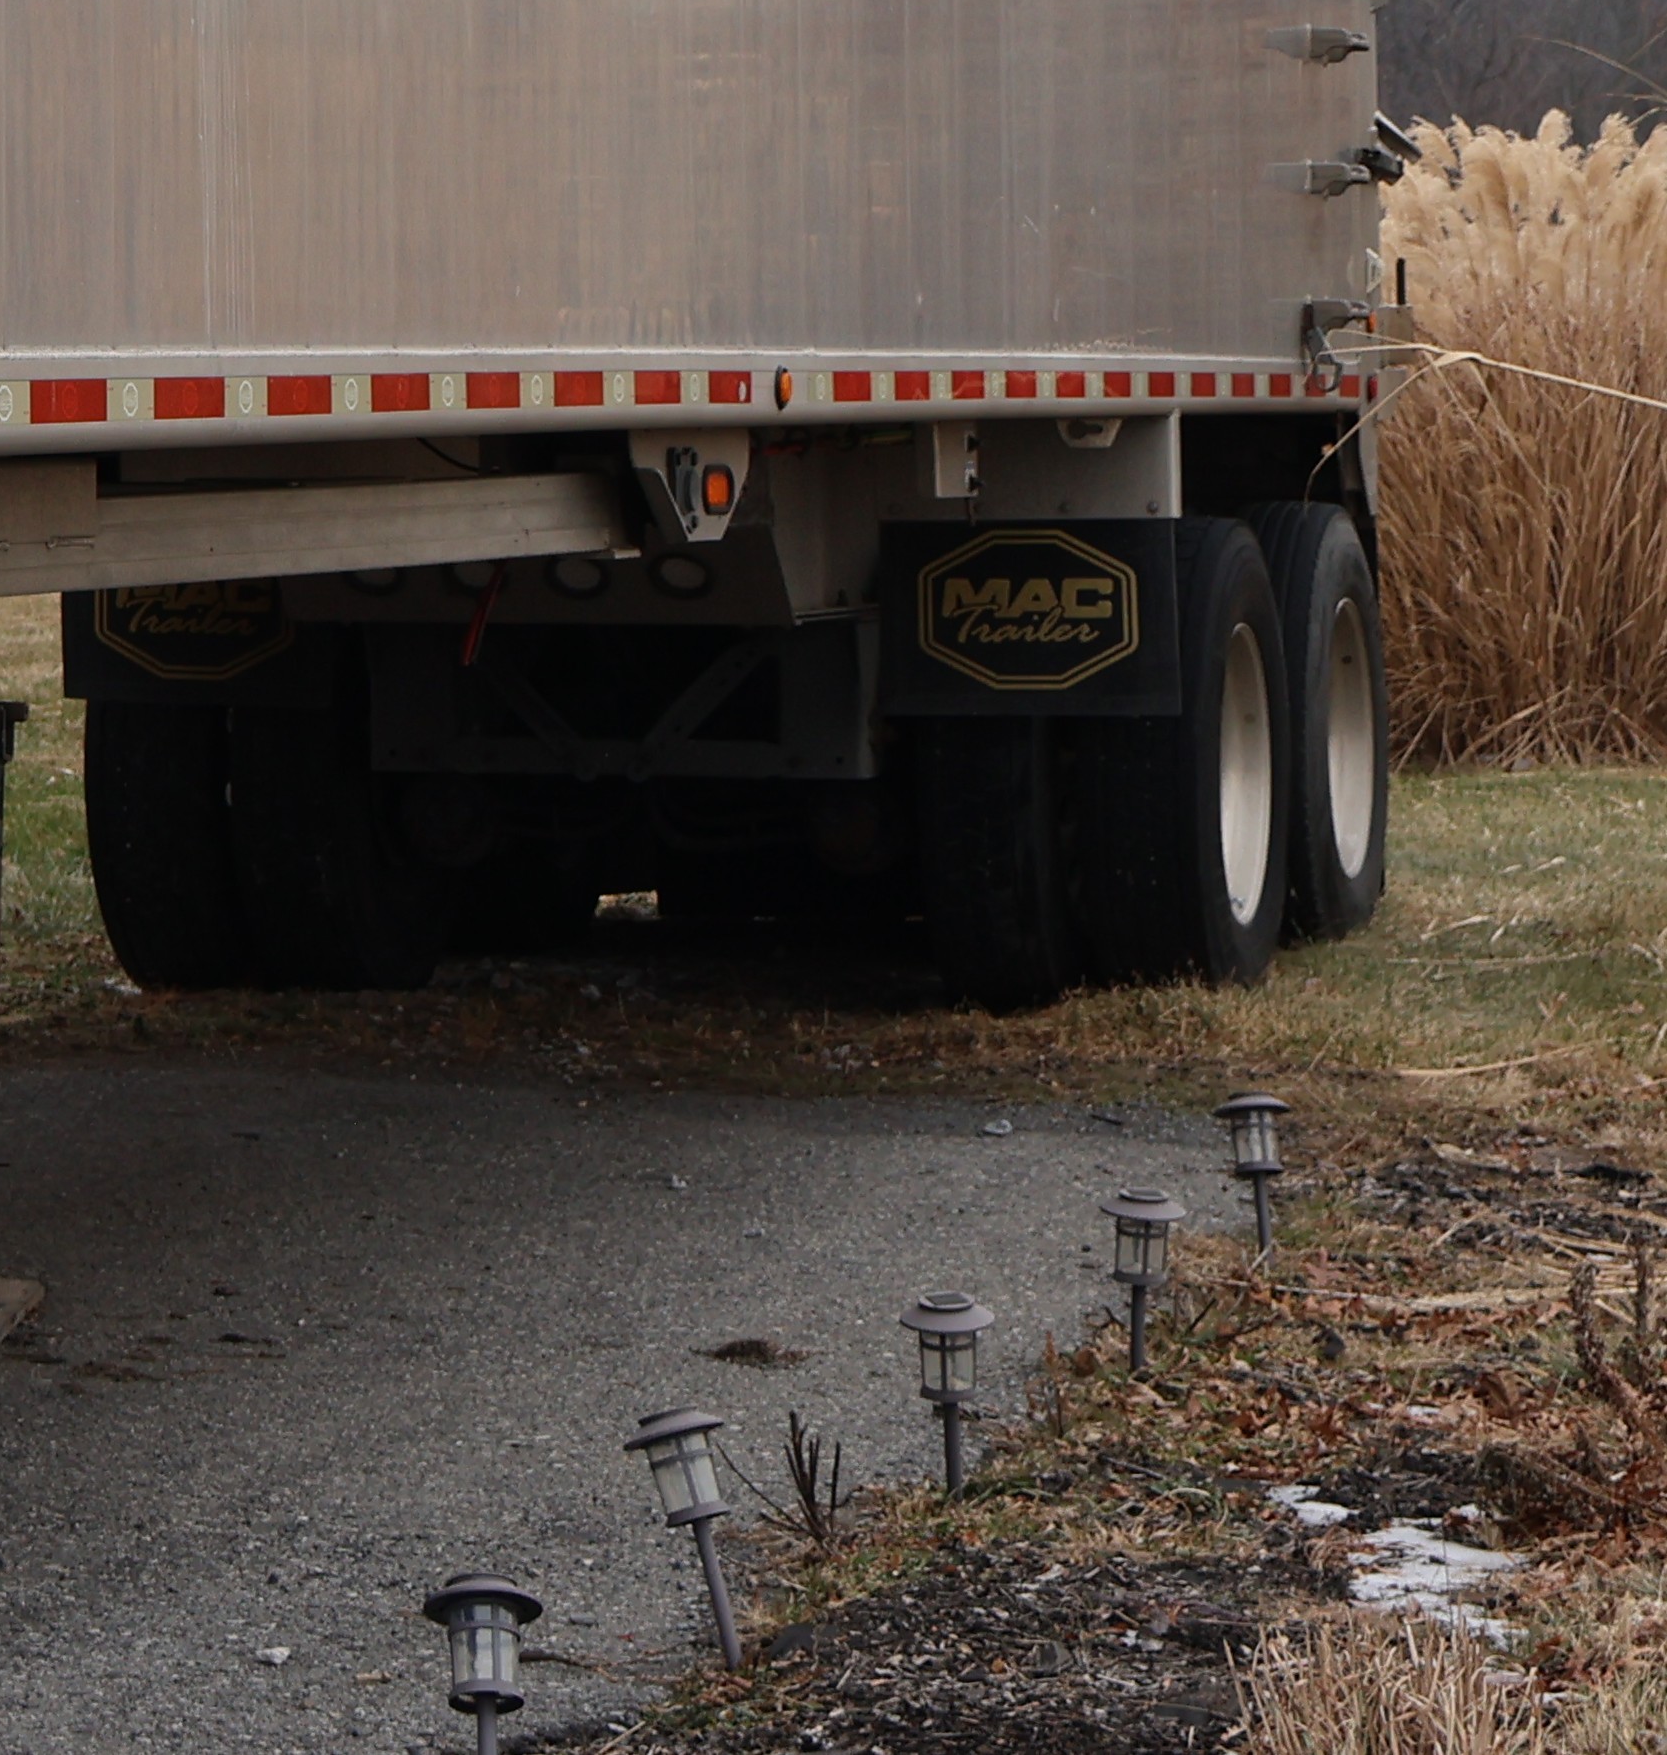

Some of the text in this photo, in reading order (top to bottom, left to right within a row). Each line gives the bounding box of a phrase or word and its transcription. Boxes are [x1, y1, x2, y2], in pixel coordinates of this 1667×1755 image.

[126, 596, 258, 636] Trailer
[941, 577, 1115, 619] MAC
[951, 604, 1101, 644] Trailer
